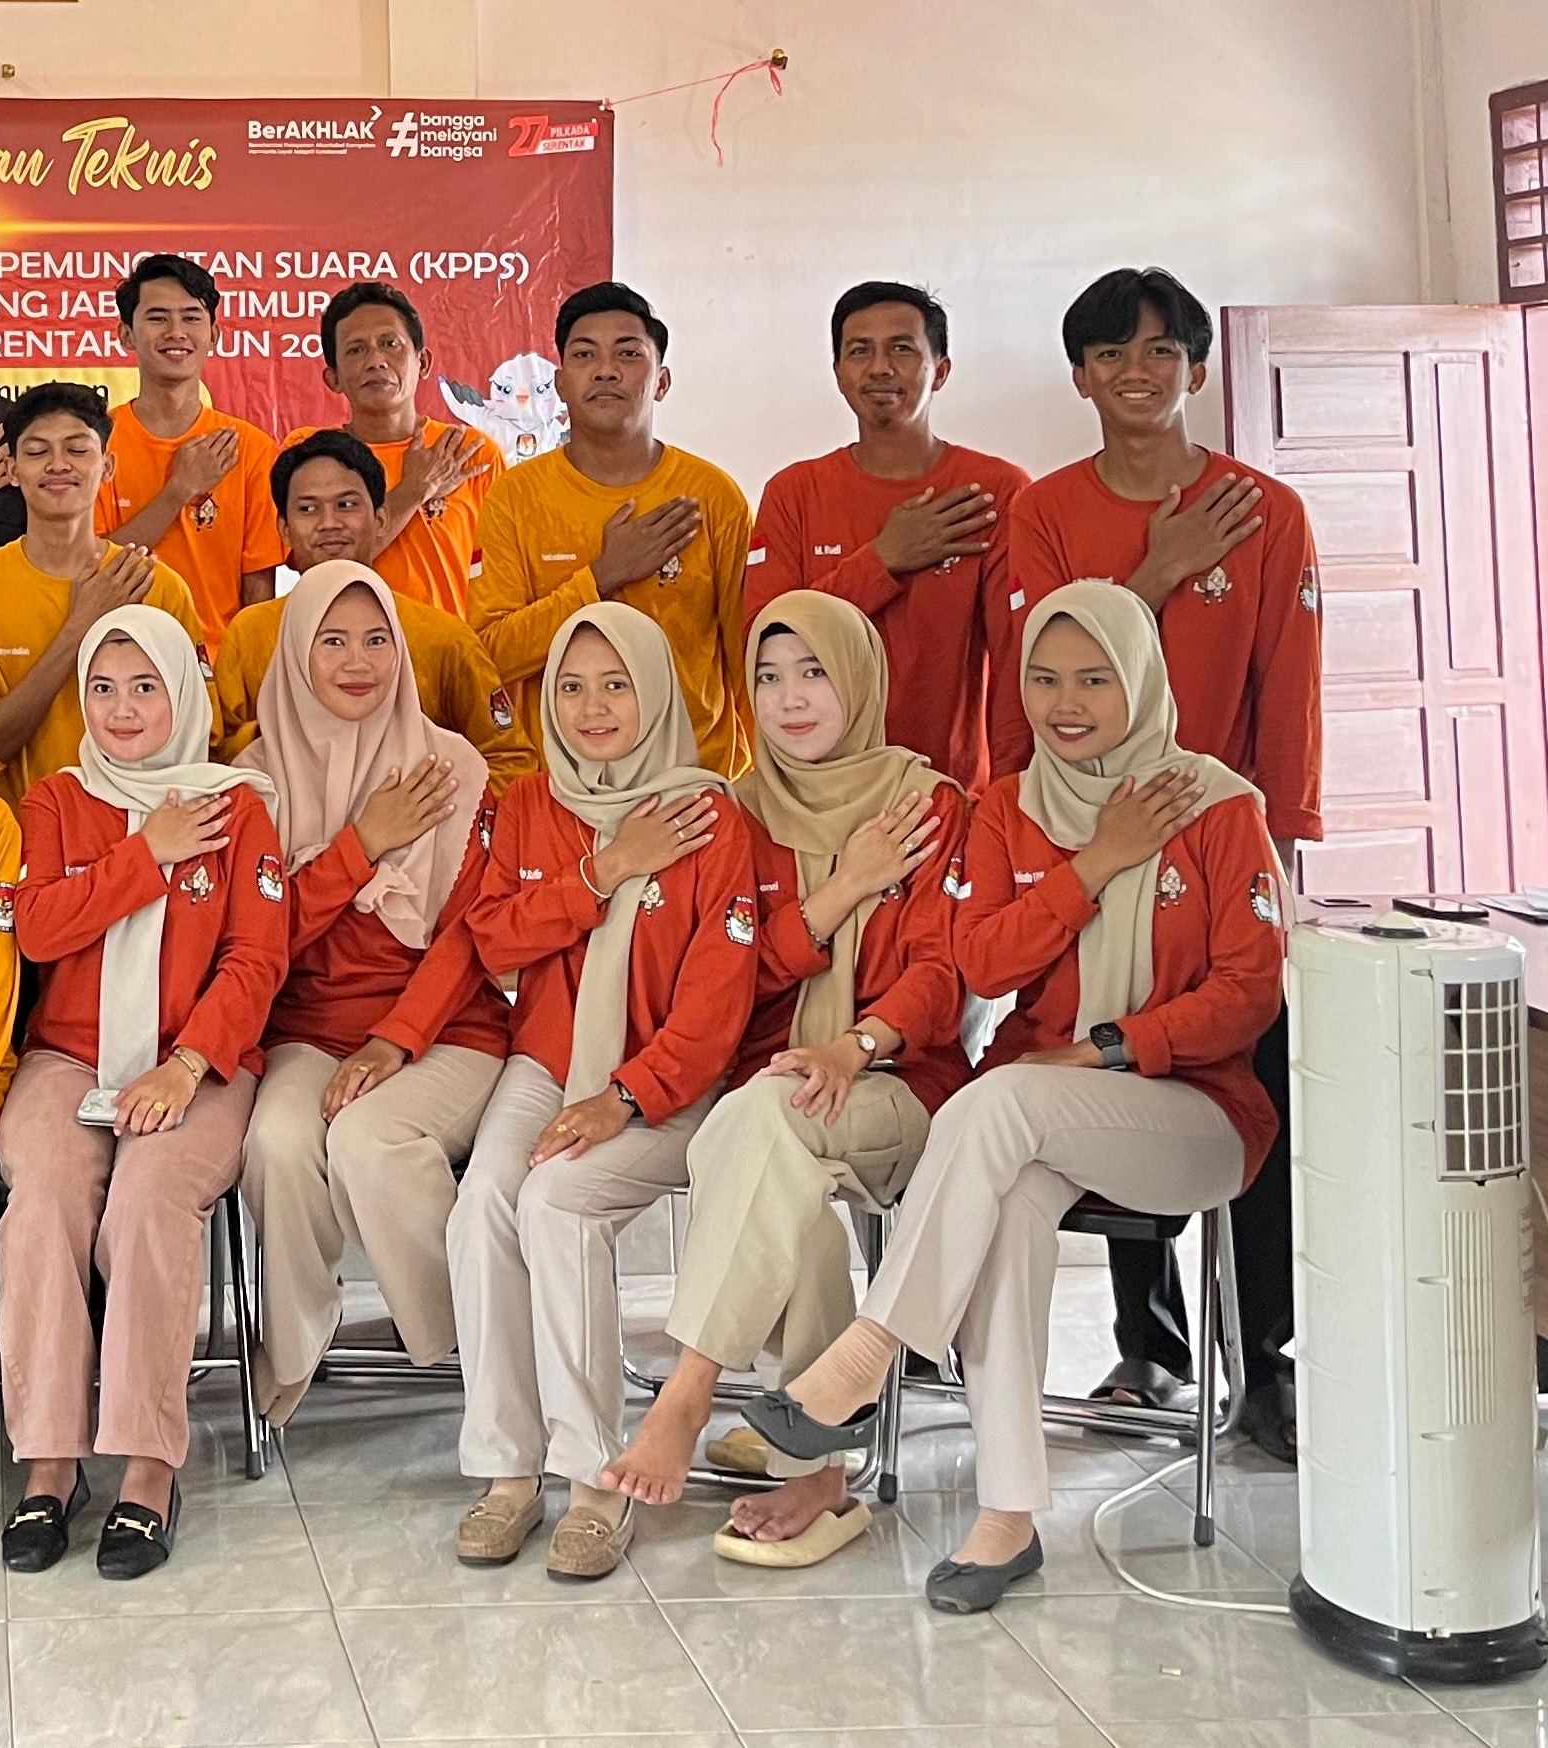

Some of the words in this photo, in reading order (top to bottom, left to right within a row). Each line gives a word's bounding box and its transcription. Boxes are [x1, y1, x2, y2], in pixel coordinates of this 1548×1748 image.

[248, 119, 375, 140] BerAKHLAK
[420, 112, 485, 131] bangga
[550, 125, 590, 138] PILKADA
[420, 126, 497, 143] melayani
[508, 114, 549, 157] 27
[420, 145, 483, 161] bangsa
[275, 250, 398, 279] SUARA
[408, 248, 530, 286] (KPPS)
[58, 290, 120, 318] JAB
[219, 290, 331, 318] TIMUR
[280, 333, 324, 358] 20
